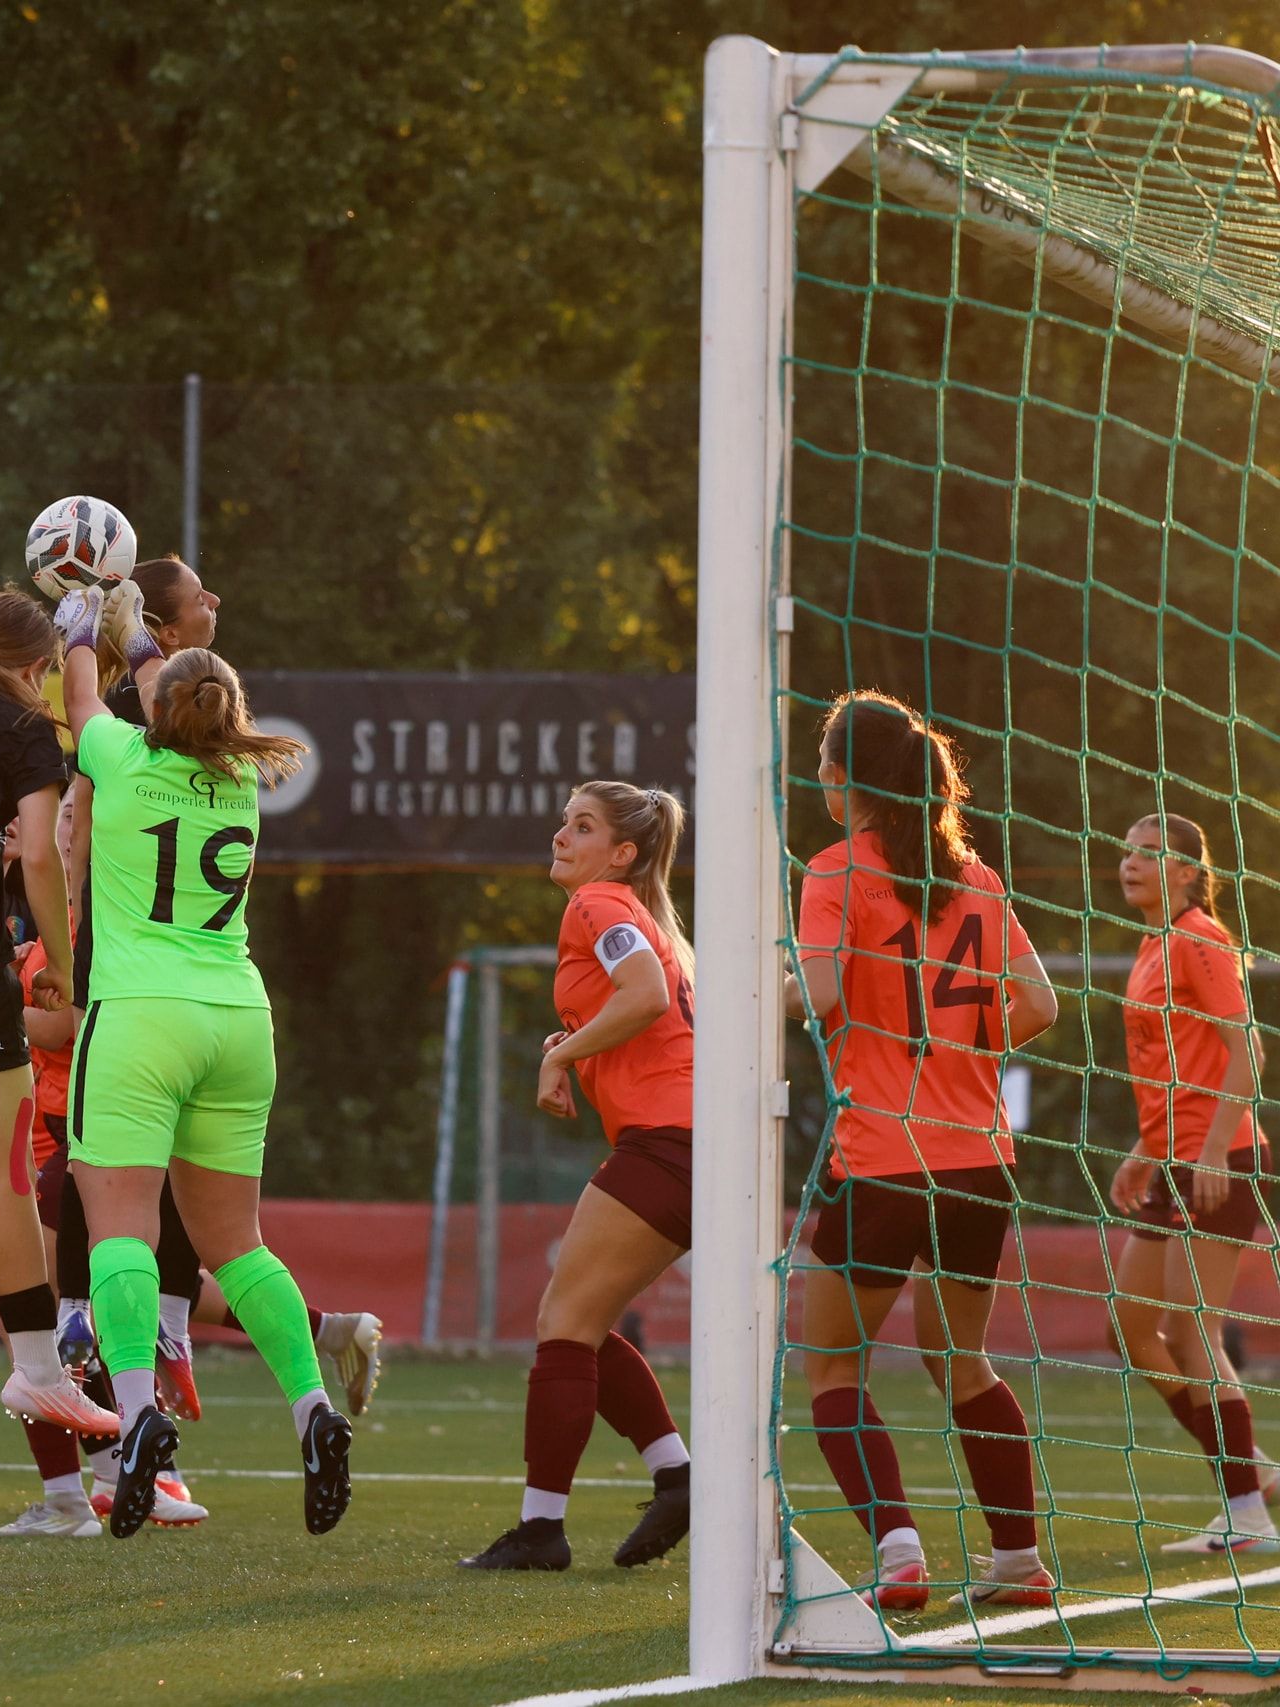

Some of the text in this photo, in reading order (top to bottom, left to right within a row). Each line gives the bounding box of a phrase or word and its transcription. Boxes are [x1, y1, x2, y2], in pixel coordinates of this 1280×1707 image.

[135, 784, 206, 809] Gemperle
[138, 816, 256, 932] 19
[880, 914, 995, 1058] 14
